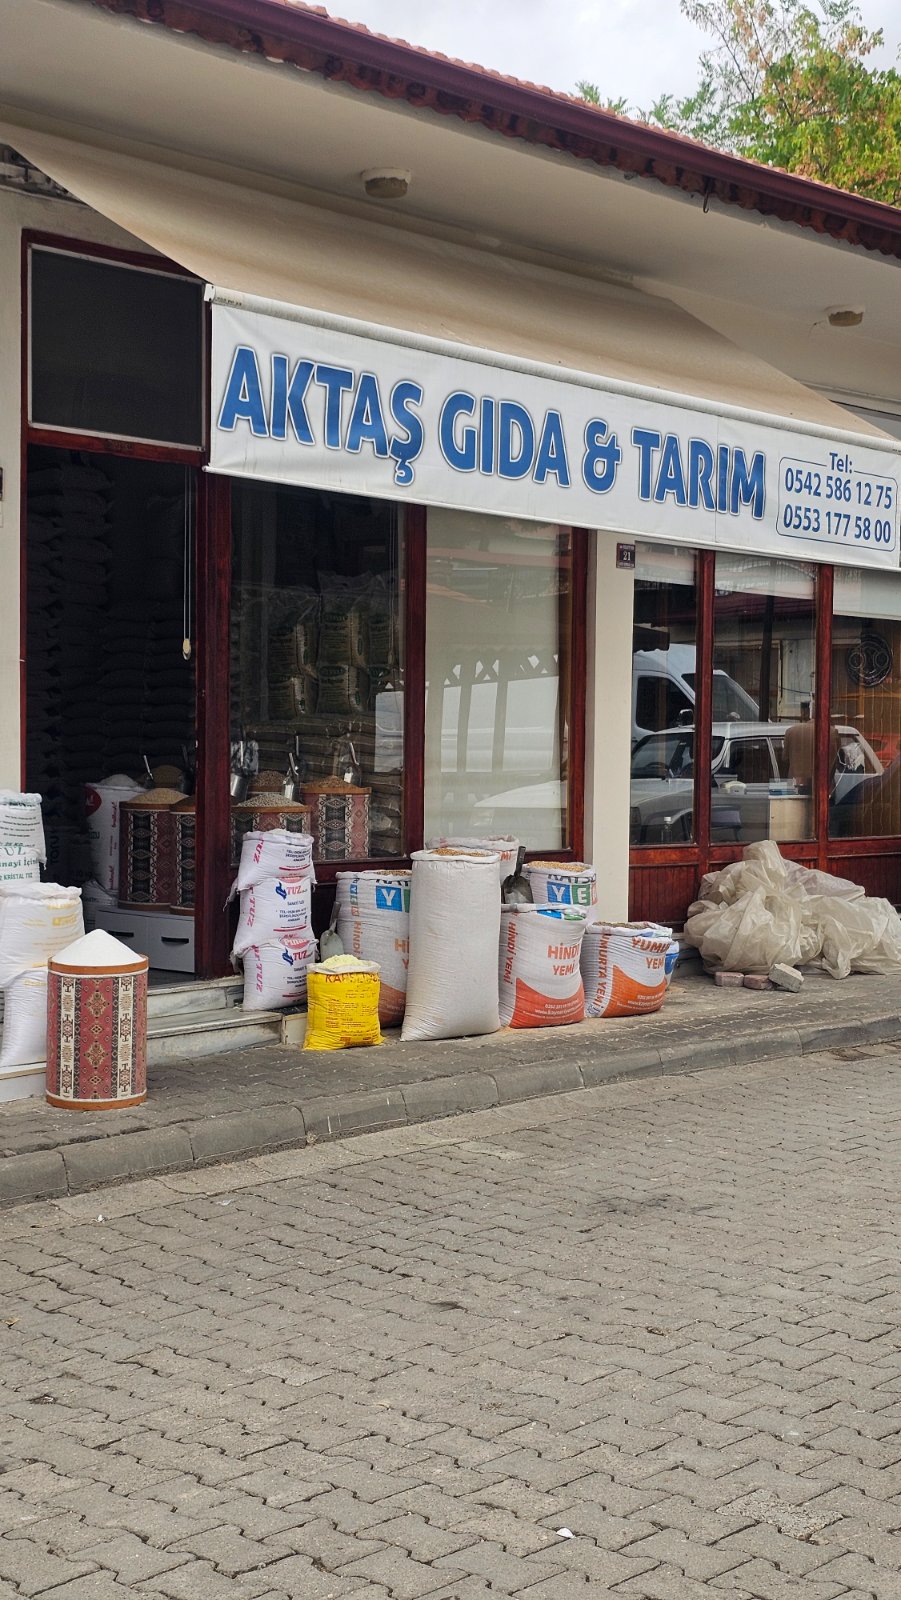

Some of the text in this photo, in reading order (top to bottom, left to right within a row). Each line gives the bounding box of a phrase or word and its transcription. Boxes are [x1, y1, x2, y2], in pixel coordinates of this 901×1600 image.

[218, 345, 766, 520] AKTAŞ GIDA & TARIM
[829, 452, 852, 474] Tel:
[785, 467, 892, 509] 0542 586 12 75
[783, 504, 891, 544] 0553 177 58 00
